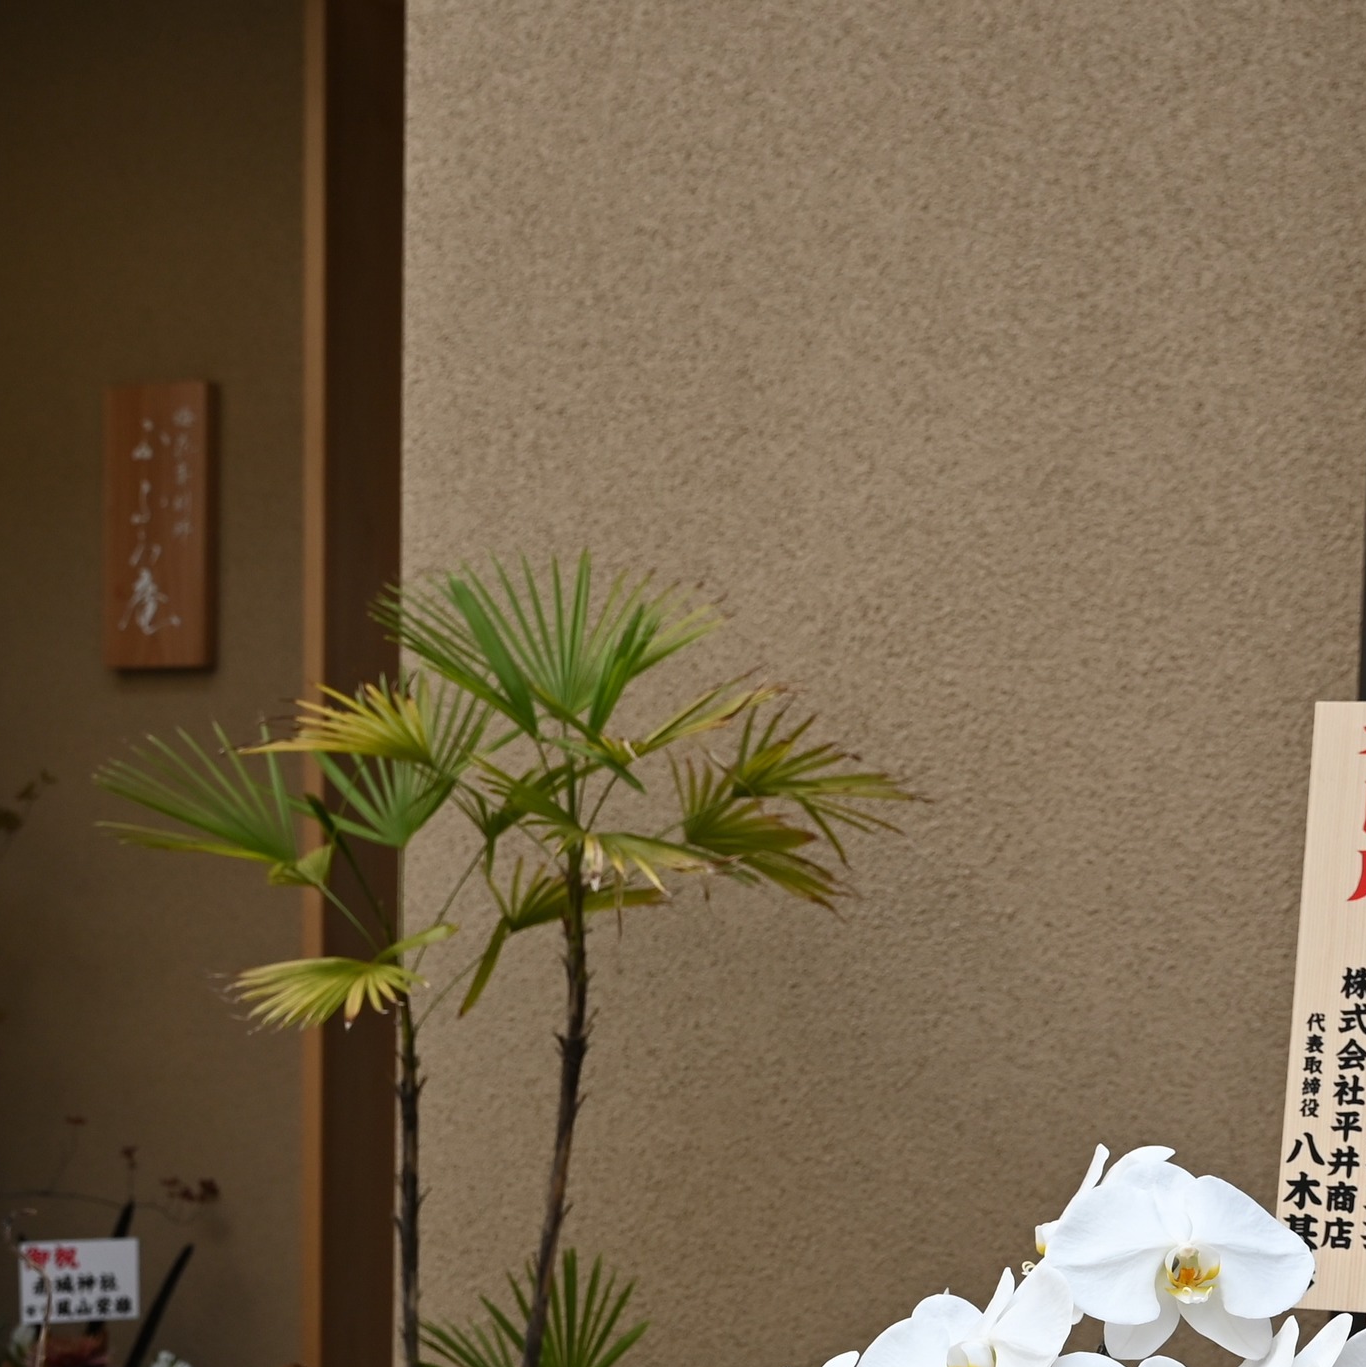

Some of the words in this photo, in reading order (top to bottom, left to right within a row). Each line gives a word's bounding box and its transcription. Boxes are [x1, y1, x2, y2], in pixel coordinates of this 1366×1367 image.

[1299, 1012, 1327, 1119] 代表取締役
